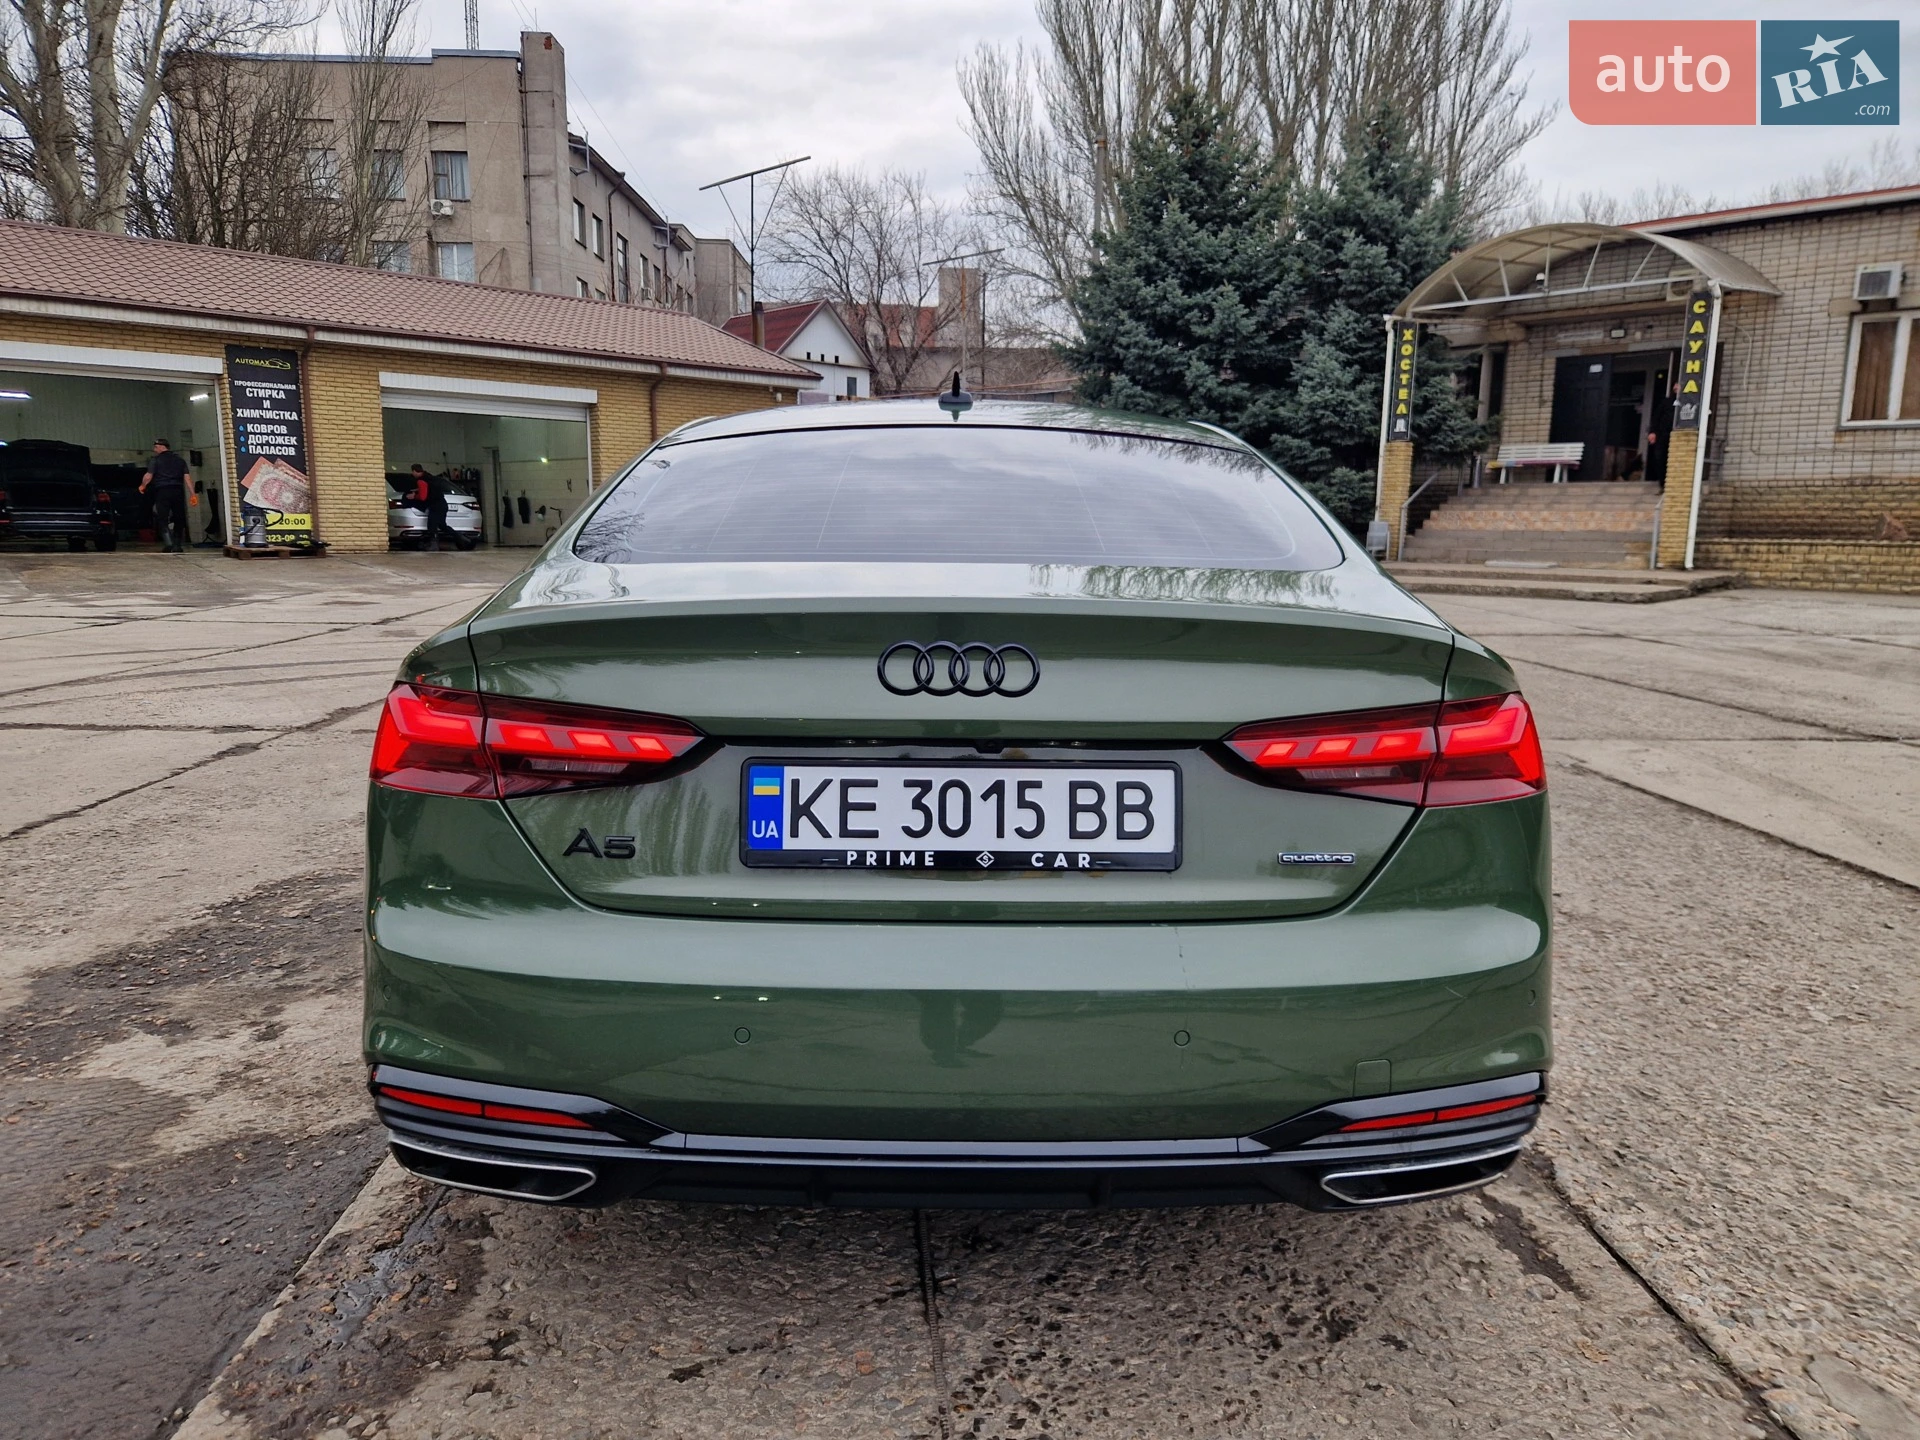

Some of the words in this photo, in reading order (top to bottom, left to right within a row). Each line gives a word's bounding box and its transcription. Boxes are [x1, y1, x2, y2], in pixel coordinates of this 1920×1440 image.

[1683, 300, 1707, 393] САУНА
[235, 358, 270, 366] AUTOMAX
[1396, 329, 1414, 415] ХОСТЕЛ
[234, 380, 297, 390] ПРОФЕССИОНАЛЬНАЯ
[246, 387, 286, 399] СТИРКА
[263, 400, 271, 409] И
[236, 408, 299, 421] ХИМЧИСТКА
[247, 423, 288, 434] КОВРОВ
[247, 434, 298, 445] ДОРОЖЕК
[249, 445, 296, 456] ПАЛАСОВ
[789, 778, 879, 838] KE
[901, 779, 1046, 839] 3015
[1069, 780, 1155, 840] BB
[752, 820, 779, 839] UA
[562, 827, 636, 859] A5
[847, 851, 935, 866] PRIME
[1031, 852, 1091, 868] CAR
[1282, 854, 1352, 863] quattro
